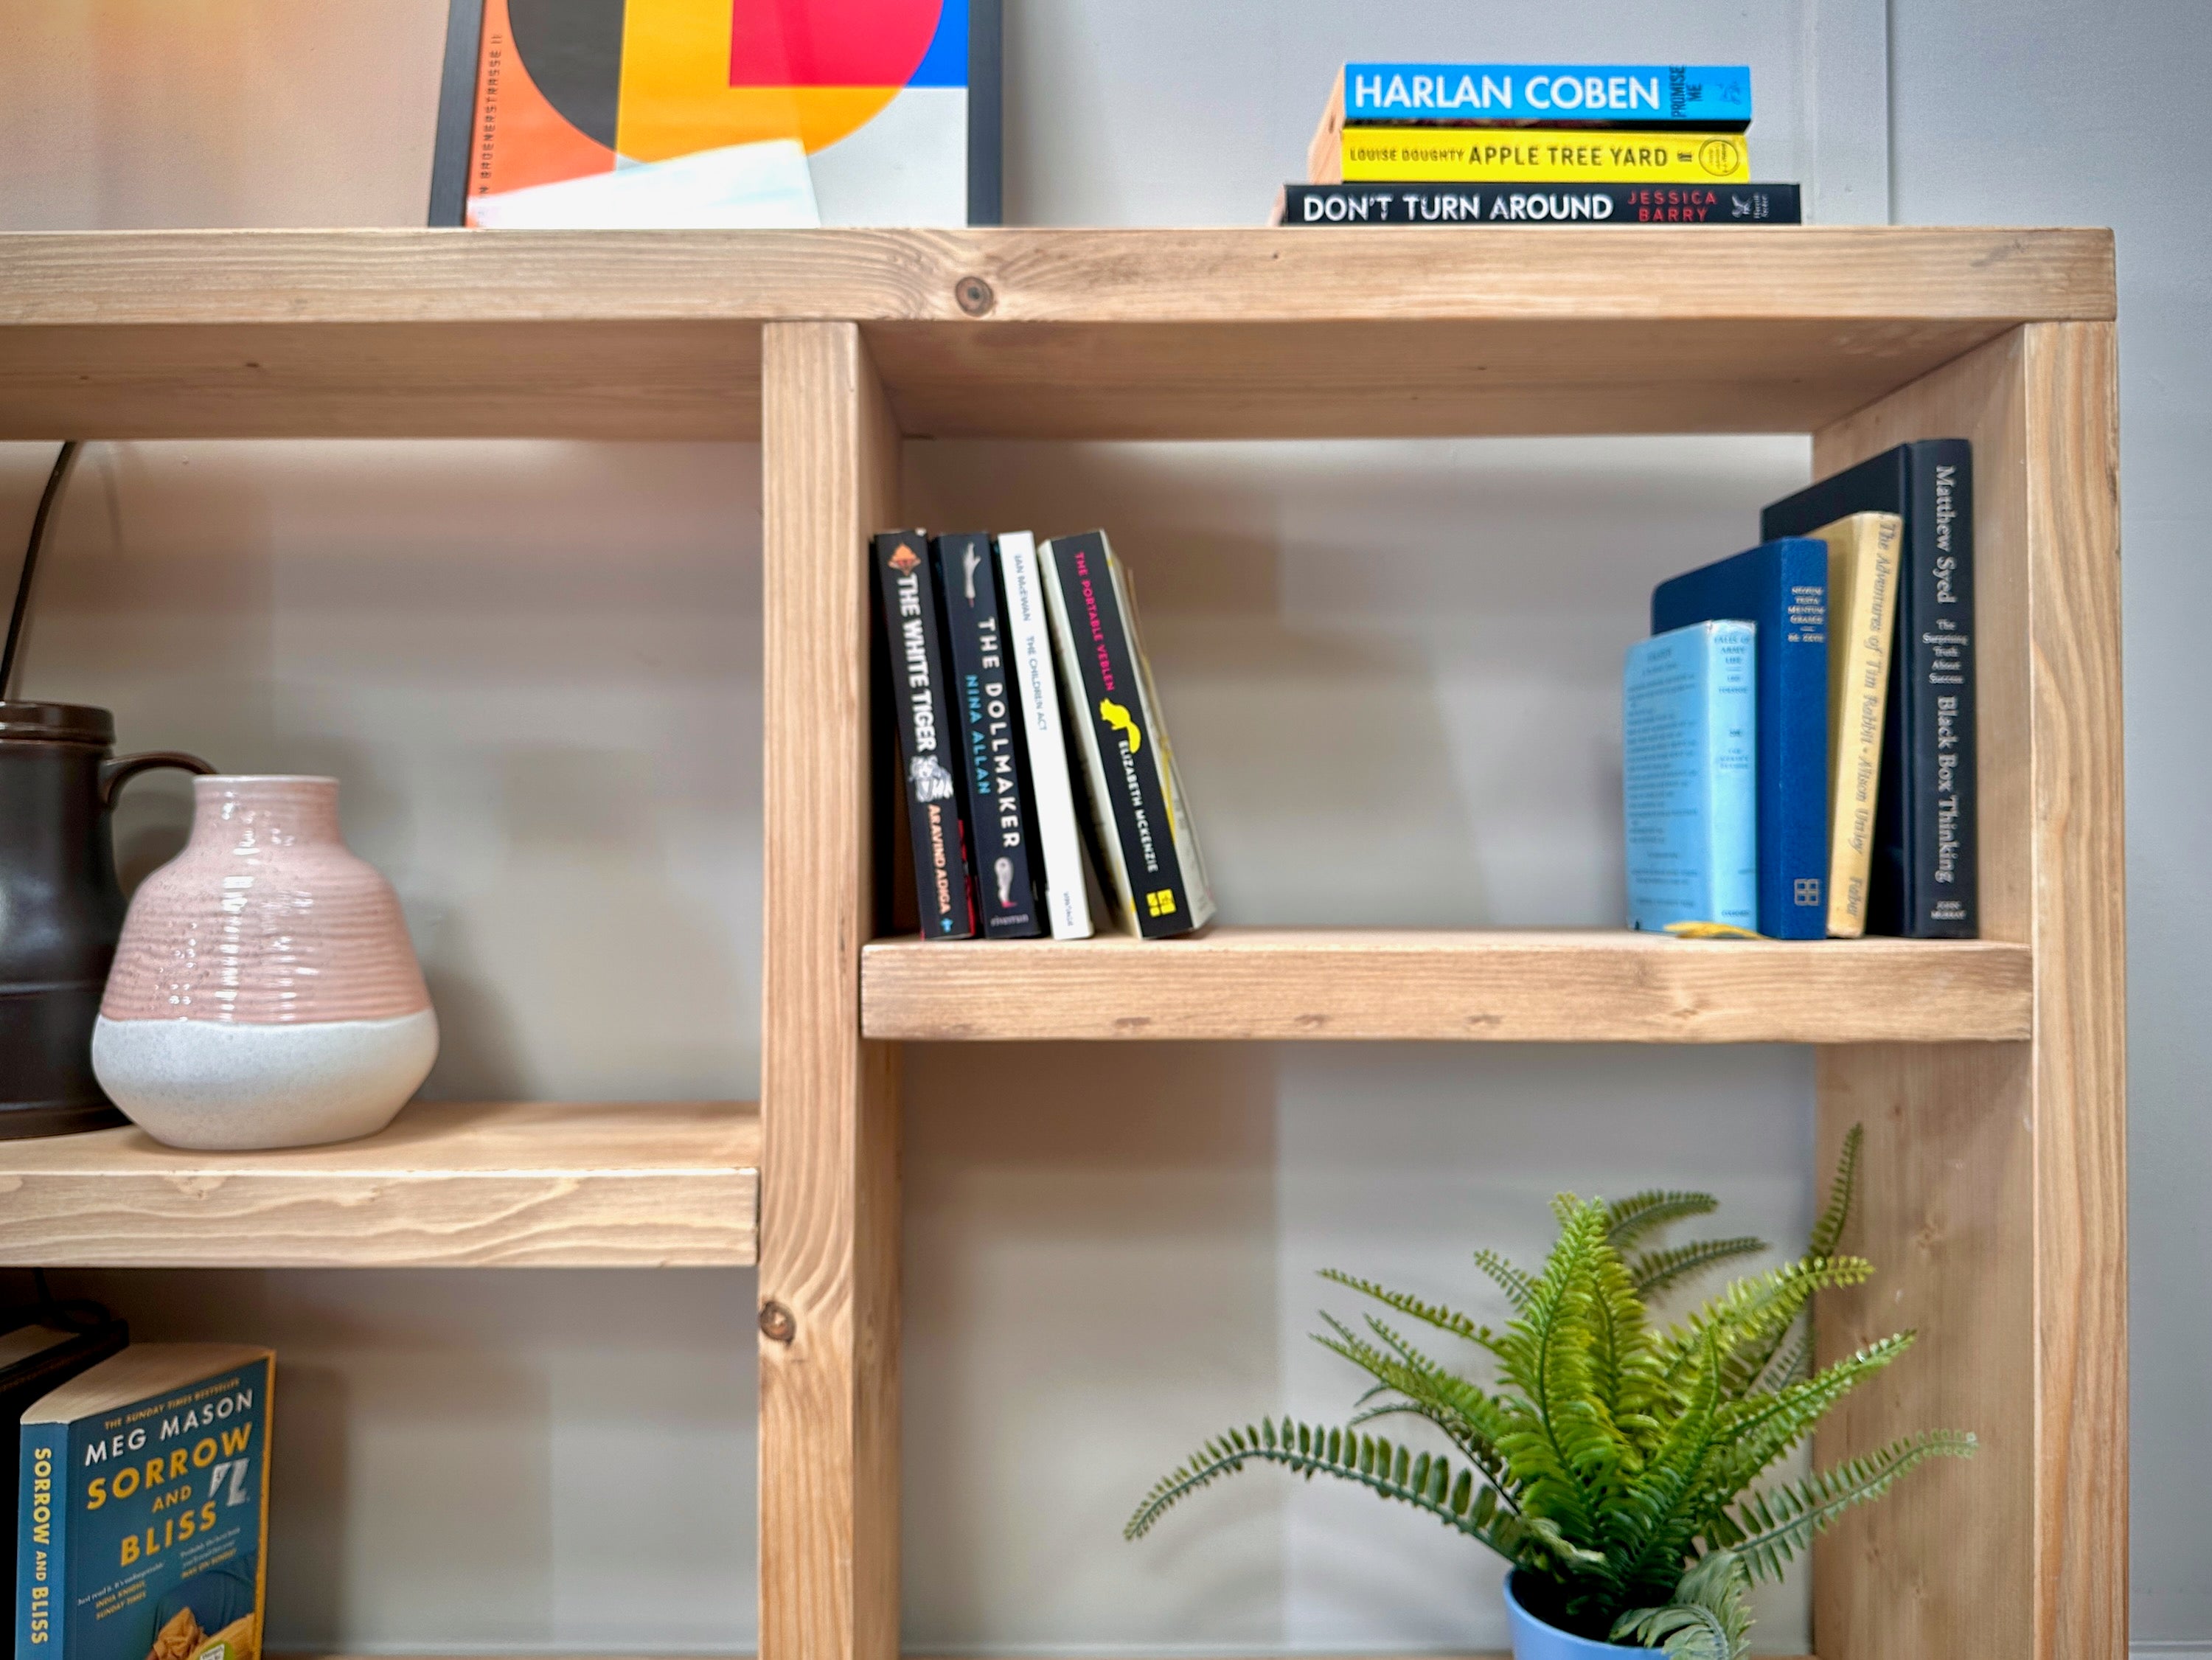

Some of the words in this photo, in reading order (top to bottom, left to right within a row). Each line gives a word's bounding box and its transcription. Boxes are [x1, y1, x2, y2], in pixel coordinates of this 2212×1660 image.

[1355, 74, 1512, 109] HARLAN
[1525, 75, 1660, 110] COBEN
[1669, 65, 1686, 118] PROMISE
[1686, 83, 1703, 102] ME
[1349, 147, 1397, 162] LOUISE
[1402, 147, 1464, 162] DOUGHTY
[1468, 147, 1540, 166] APPLE
[1548, 147, 1602, 166] TREE
[1610, 147, 1667, 167] YARD
[1303, 193, 1393, 222] DON'T
[1402, 193, 1481, 220] TURN
[1489, 193, 1614, 220] AROUND
[1627, 190, 1717, 205] JESSICA
[1638, 207, 1708, 222] BARRY
[1935, 465, 1957, 552] Matthew
[1878, 524, 1896, 550] The
[1014, 554, 1024, 574] IAN
[1075, 552, 1088, 577] THE
[1933, 556, 1957, 604] Syed
[897, 574, 920, 617] THE
[1016, 575, 1032, 622] McEWAN
[1081, 580, 1105, 641] PORTABLE
[1870, 555, 1891, 632] Adventures
[978, 617, 1001, 669] THE
[1026, 636, 1037, 657] THE
[1864, 635, 1882, 656] of
[1936, 619, 1955, 631] The
[901, 618, 928, 687] WHITE
[1096, 643, 1116, 692] VEBLEN
[1864, 660, 1880, 689] Tim
[1932, 660, 1961, 670] About
[1933, 646, 1959, 657] Truth
[966, 674, 984, 723] NINA
[1028, 657, 1045, 710] CHILDREN
[911, 689, 938, 753] TIGER
[1037, 712, 1048, 732] ACT
[1860, 694, 1878, 745] Rabbit
[1938, 695, 1958, 749] Black
[971, 730, 990, 795] ALLAN
[987, 682, 1020, 848] DOLLMAKER
[1938, 753, 1958, 793] Box
[1119, 740, 1141, 809] ELIZABETH
[1135, 809, 1158, 872] MCKENZIE
[928, 805, 947, 868] ARAVIND
[1935, 794, 1961, 883] Thinking
[935, 868, 952, 915] ADIGA
[85, 1428, 147, 1467] MEG
[159, 1389, 254, 1441] MASON
[105, 1417, 123, 1431] THE
[126, 1404, 166, 1425] SUNDAY
[167, 1394, 192, 1410] TIMES
[193, 1377, 240, 1401] BESTSELLER
[86, 1422, 252, 1510] SORROW
[32, 1448, 52, 1545] SORROW
[151, 1485, 192, 1514] AND
[120, 1501, 217, 1567] BLISS
[35, 1551, 48, 1581] AND
[31, 1587, 49, 1645] BLISS
[96, 1600, 125, 1621] SUNDAY
